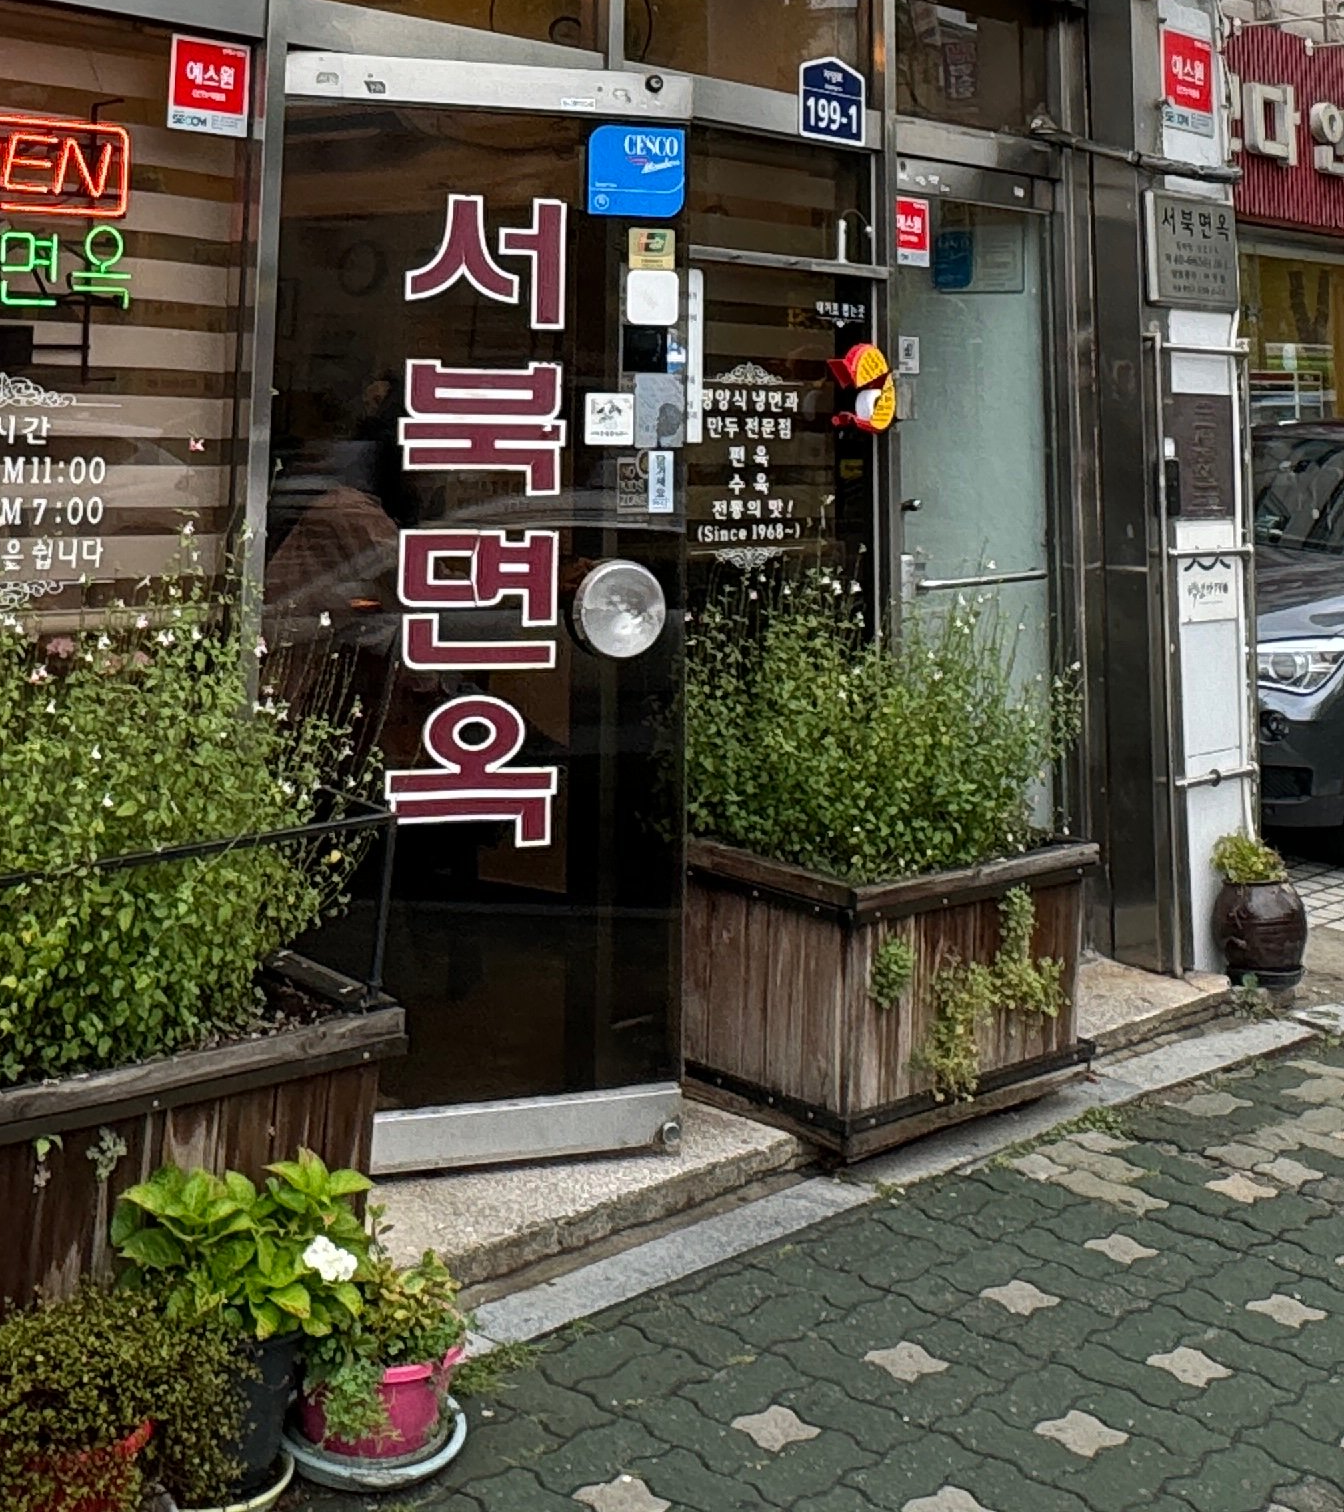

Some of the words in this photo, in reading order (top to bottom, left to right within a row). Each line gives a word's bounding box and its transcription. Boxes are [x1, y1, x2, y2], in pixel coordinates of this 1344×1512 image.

[806, 96, 858, 135] 199-1
[624, 134, 679, 157] CESCO
[1160, 205, 1231, 243] 서북면옥
[751, 390, 799, 412] 냉면과
[707, 417, 740, 439] 만두
[744, 417, 792, 439] 전문점
[385, 193, 568, 847] 서북면옥
[30, 540, 105, 571] 쉽니다
